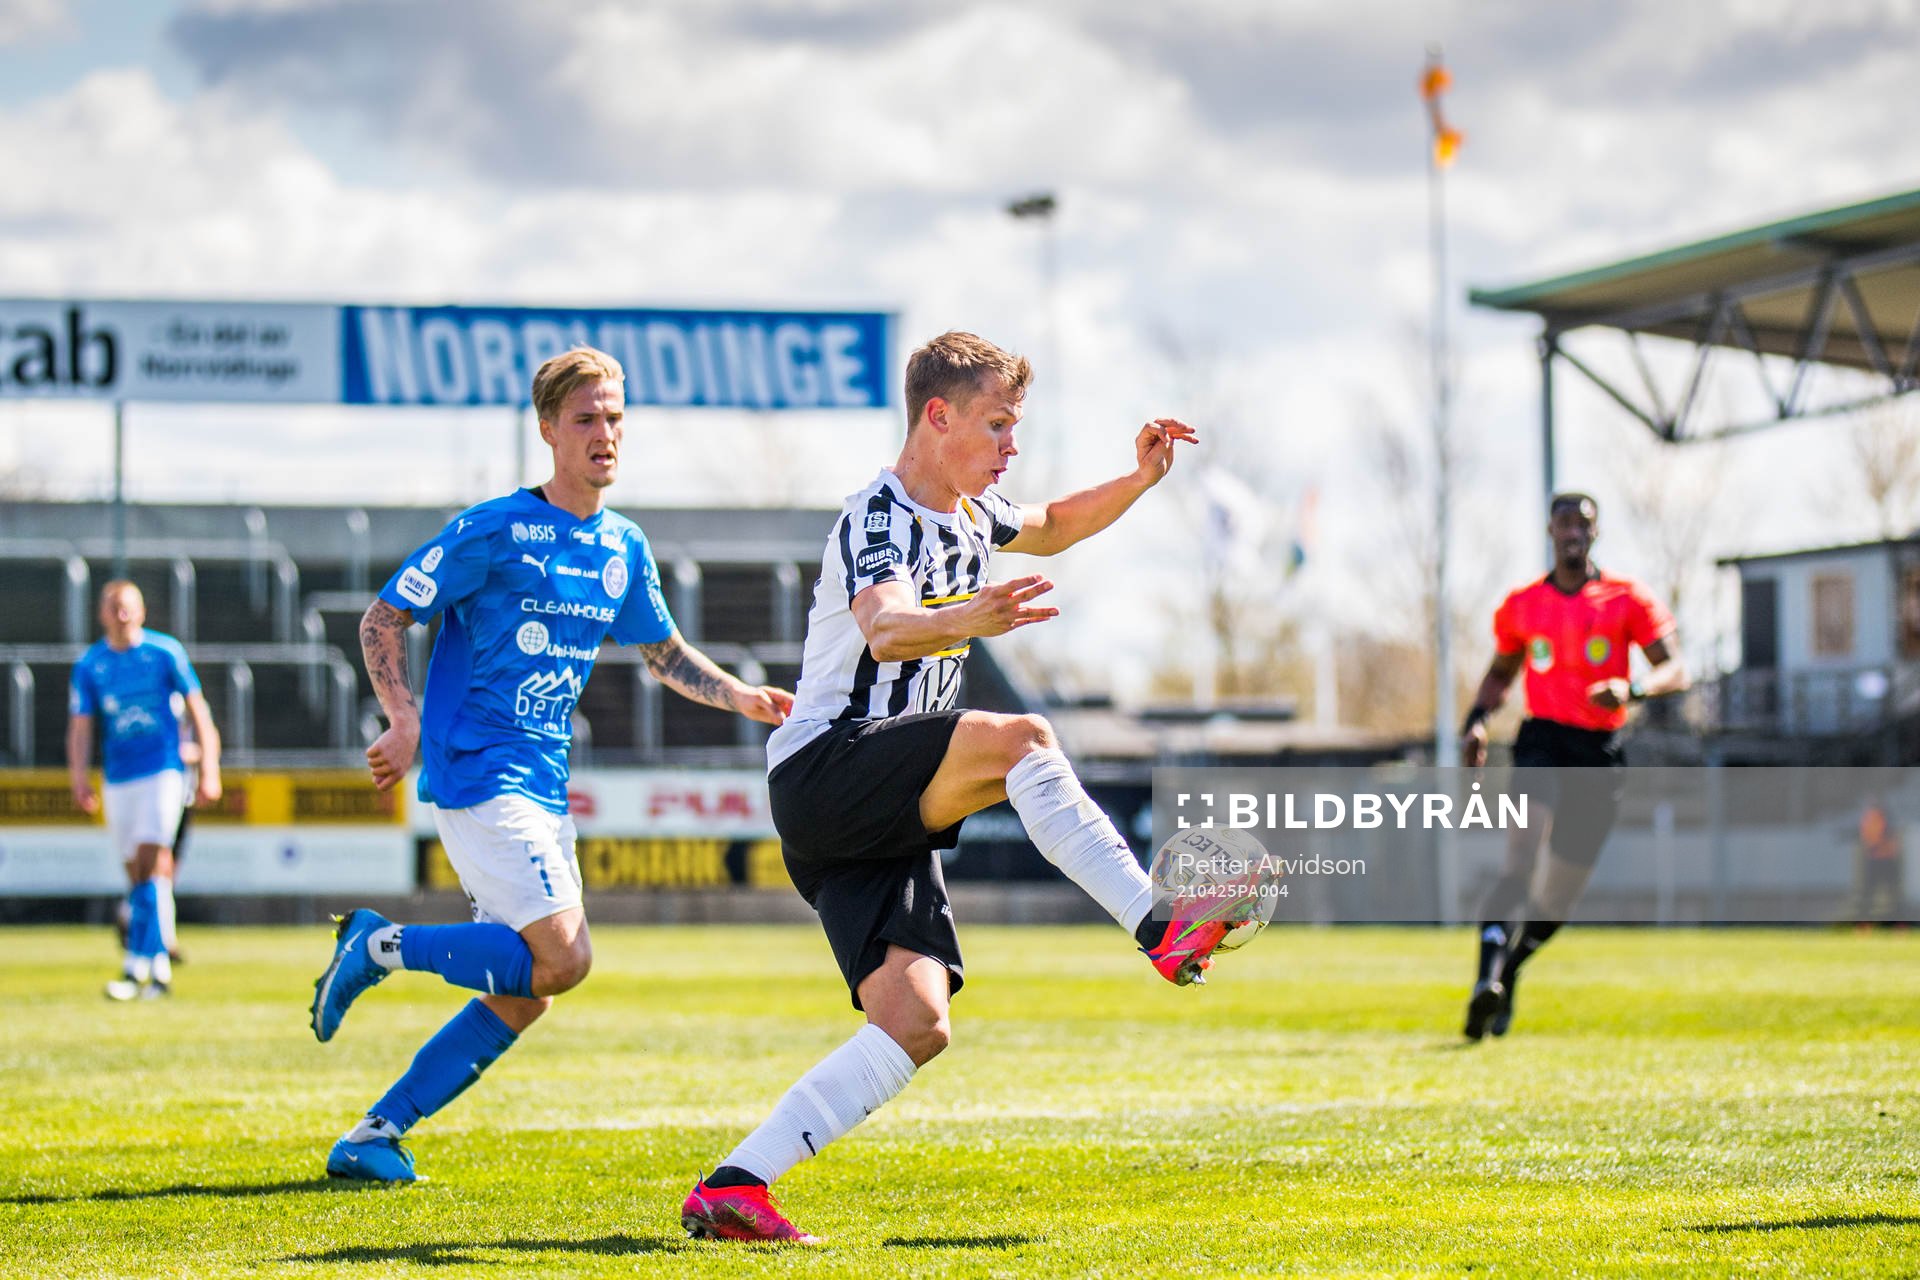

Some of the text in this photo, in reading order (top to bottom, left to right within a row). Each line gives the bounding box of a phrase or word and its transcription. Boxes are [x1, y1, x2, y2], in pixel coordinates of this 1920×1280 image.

[0, 306, 117, 387] ab
[529, 524, 557, 542] BSIS
[858, 548, 900, 567] UNIBET
[404, 573, 434, 596] UNIBET
[521, 598, 616, 622] CLEANHOUSE
